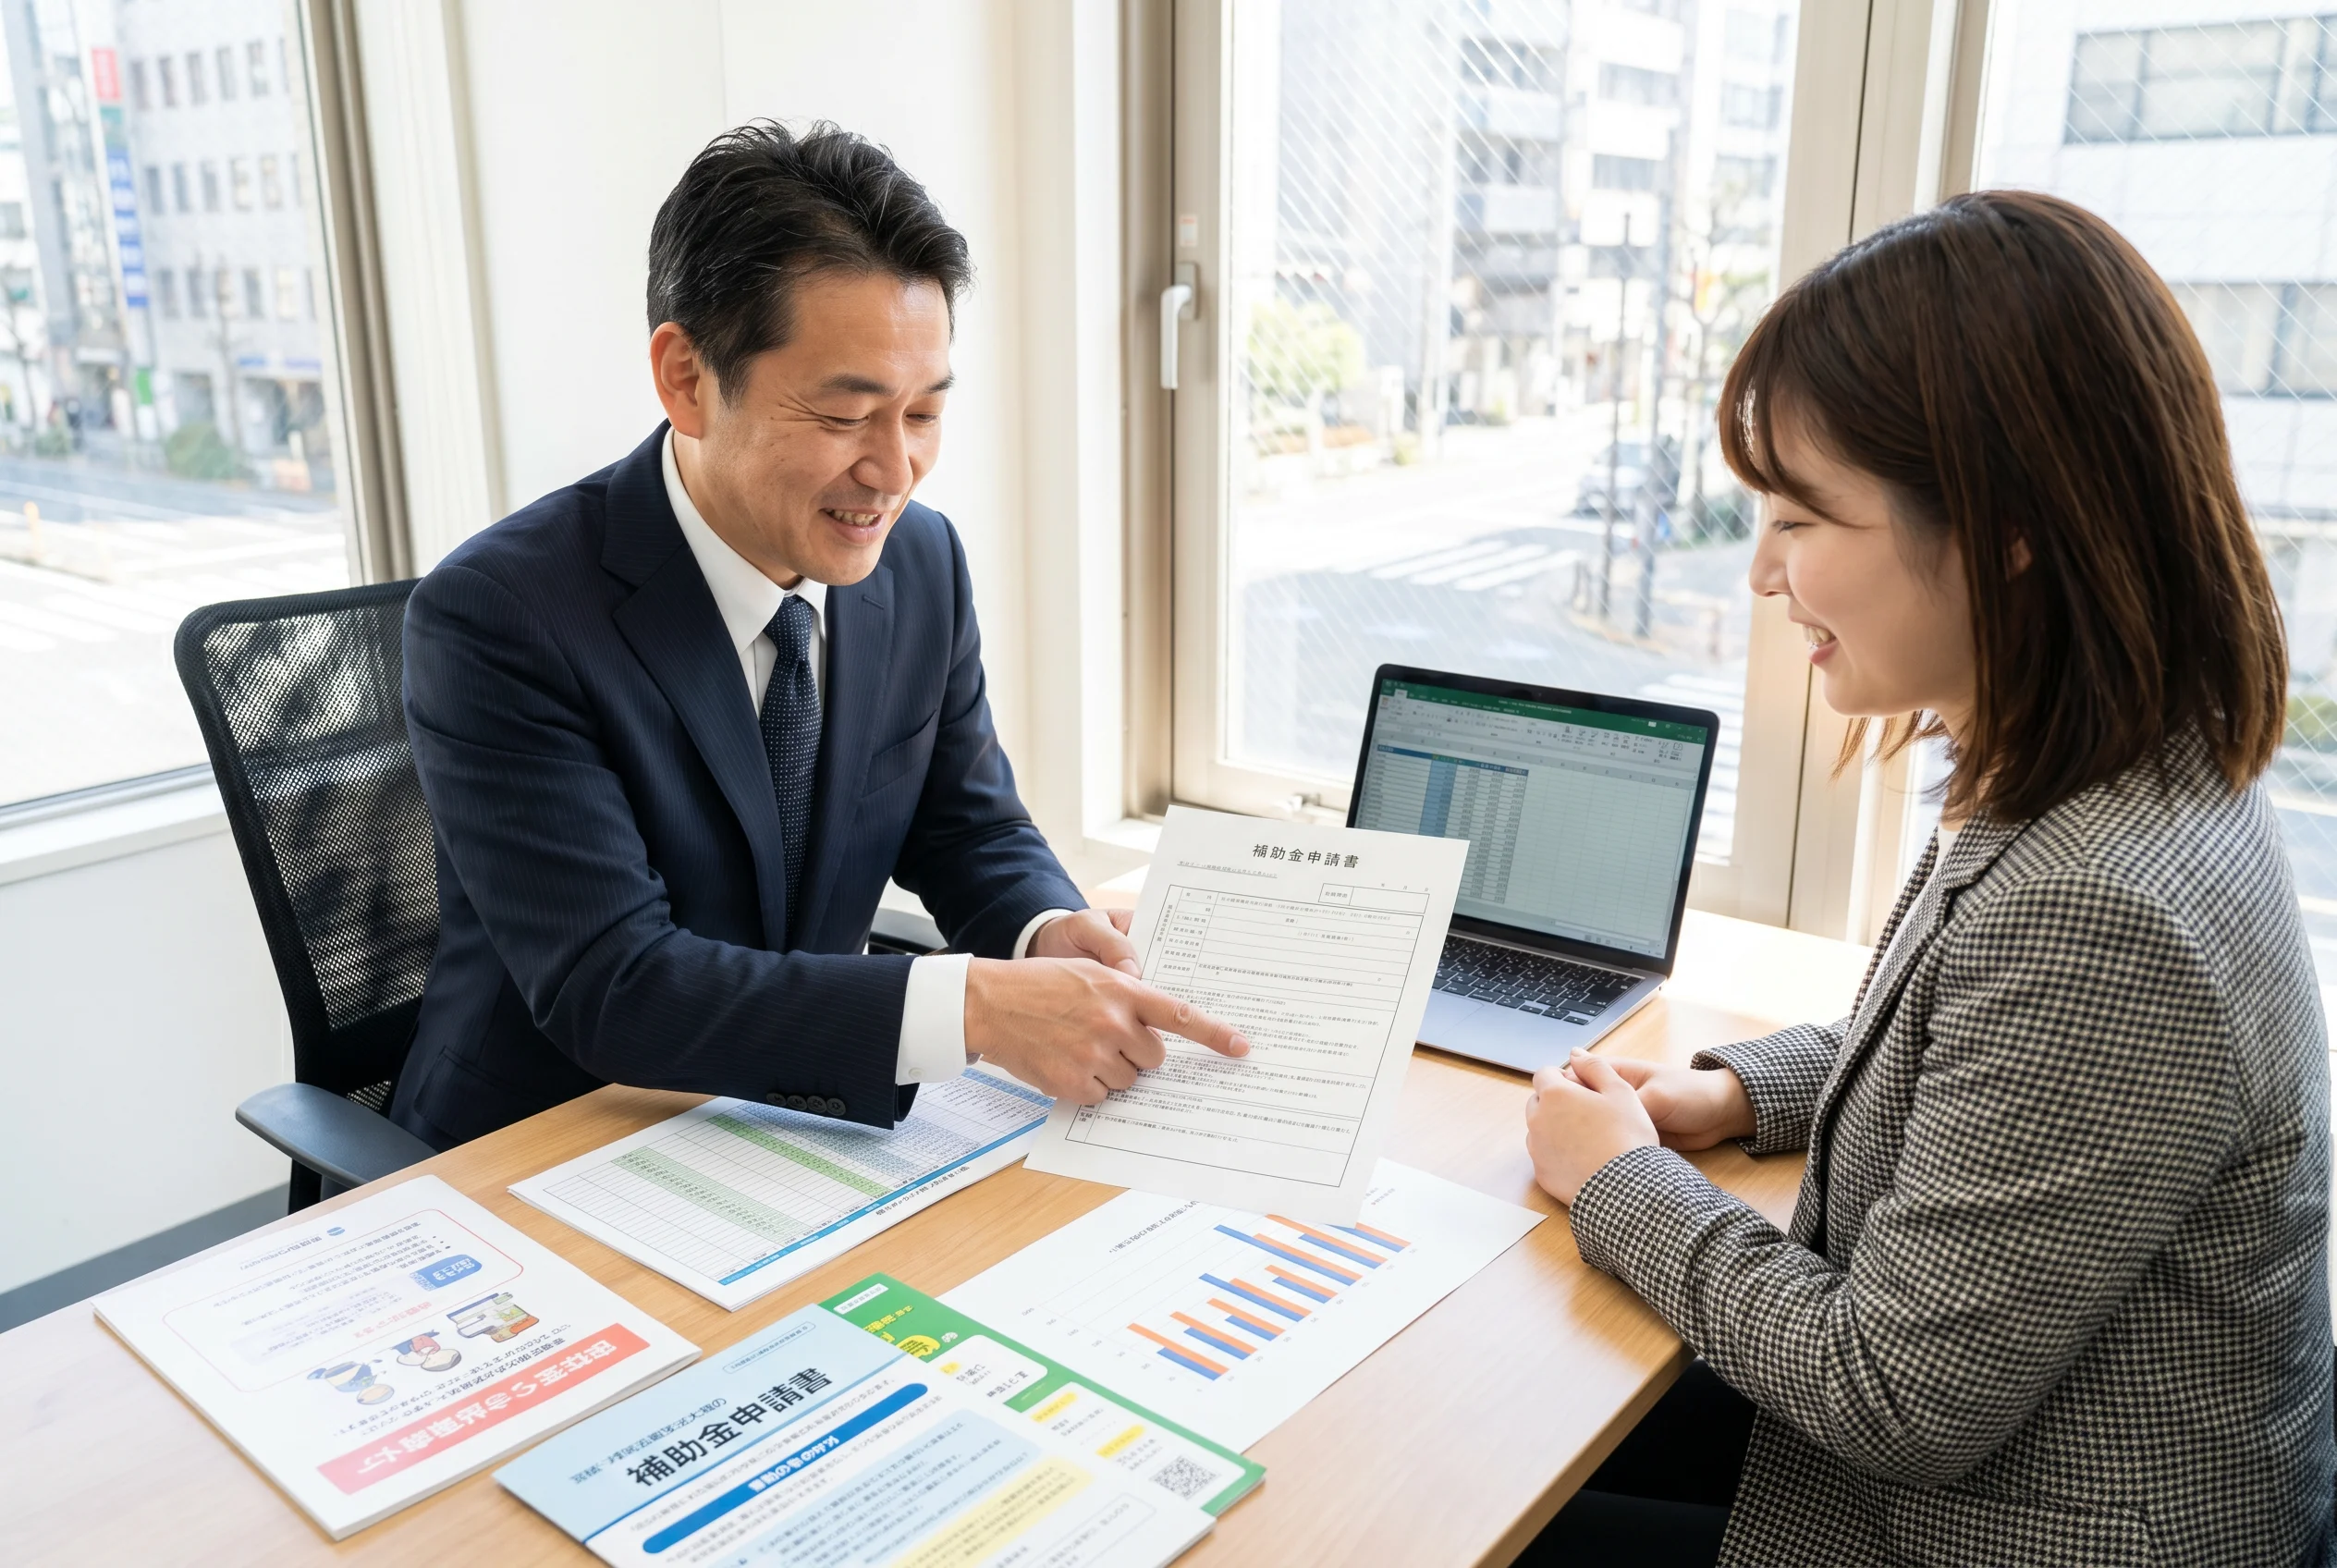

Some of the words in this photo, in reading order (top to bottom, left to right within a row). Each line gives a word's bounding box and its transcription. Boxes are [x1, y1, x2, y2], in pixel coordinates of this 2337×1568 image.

[1253, 844, 1359, 868] 補助金申請書
[627, 1367, 833, 1486] 補助金申請書
